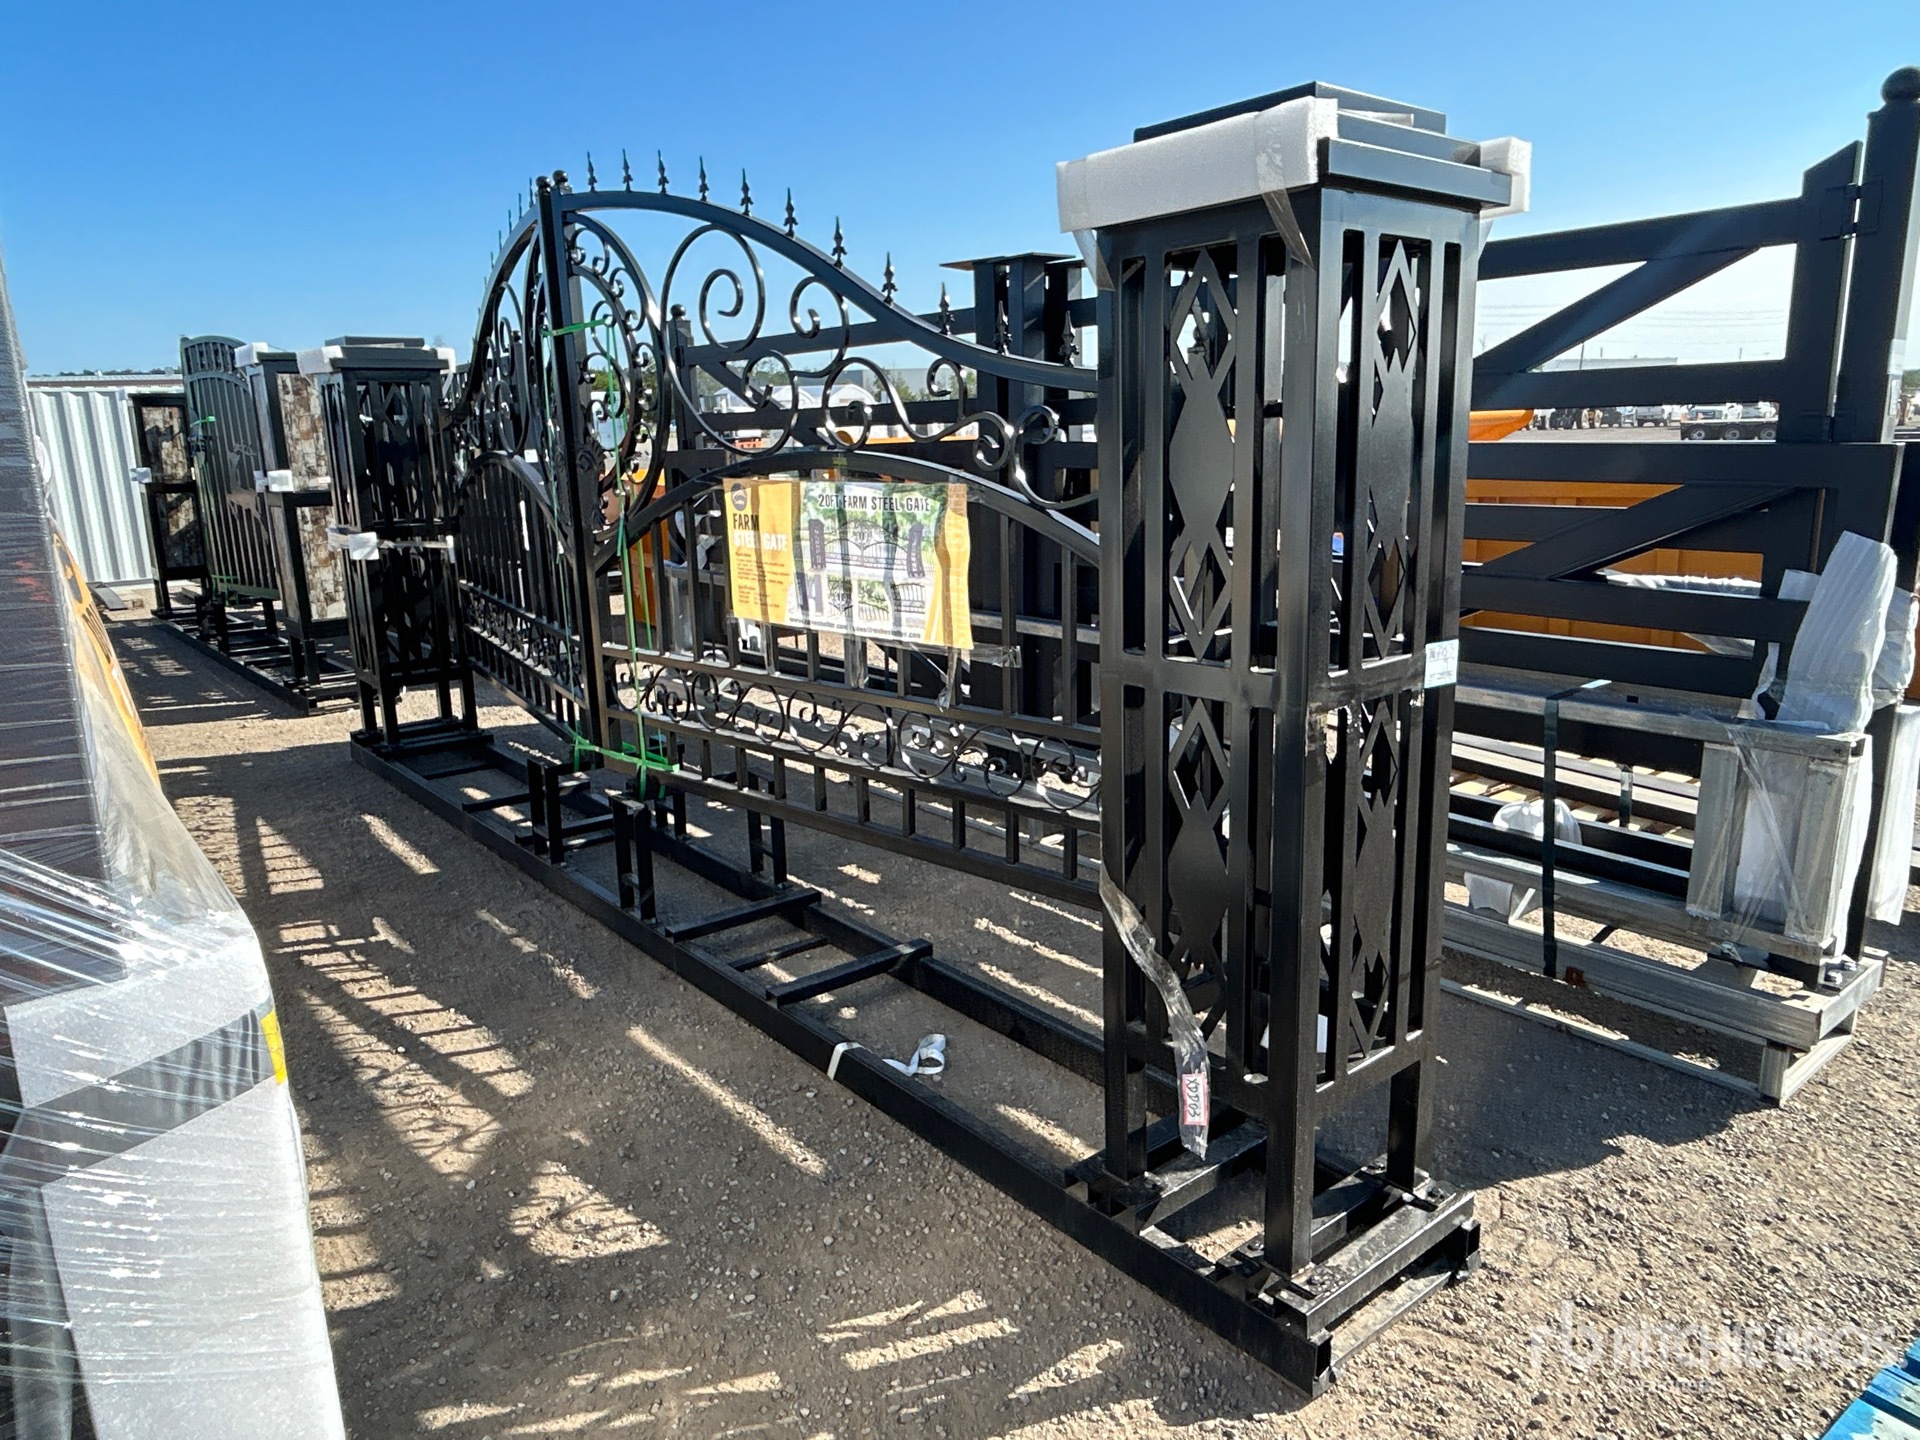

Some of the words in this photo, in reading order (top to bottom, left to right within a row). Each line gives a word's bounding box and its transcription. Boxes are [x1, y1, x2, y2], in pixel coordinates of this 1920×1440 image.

[818, 494, 840, 508] 20FT
[843, 495, 868, 509] FARM
[871, 497, 900, 511] STEEL
[906, 497, 930, 511] GATE
[732, 513, 760, 532] FARM
[763, 533, 788, 551] GATE
